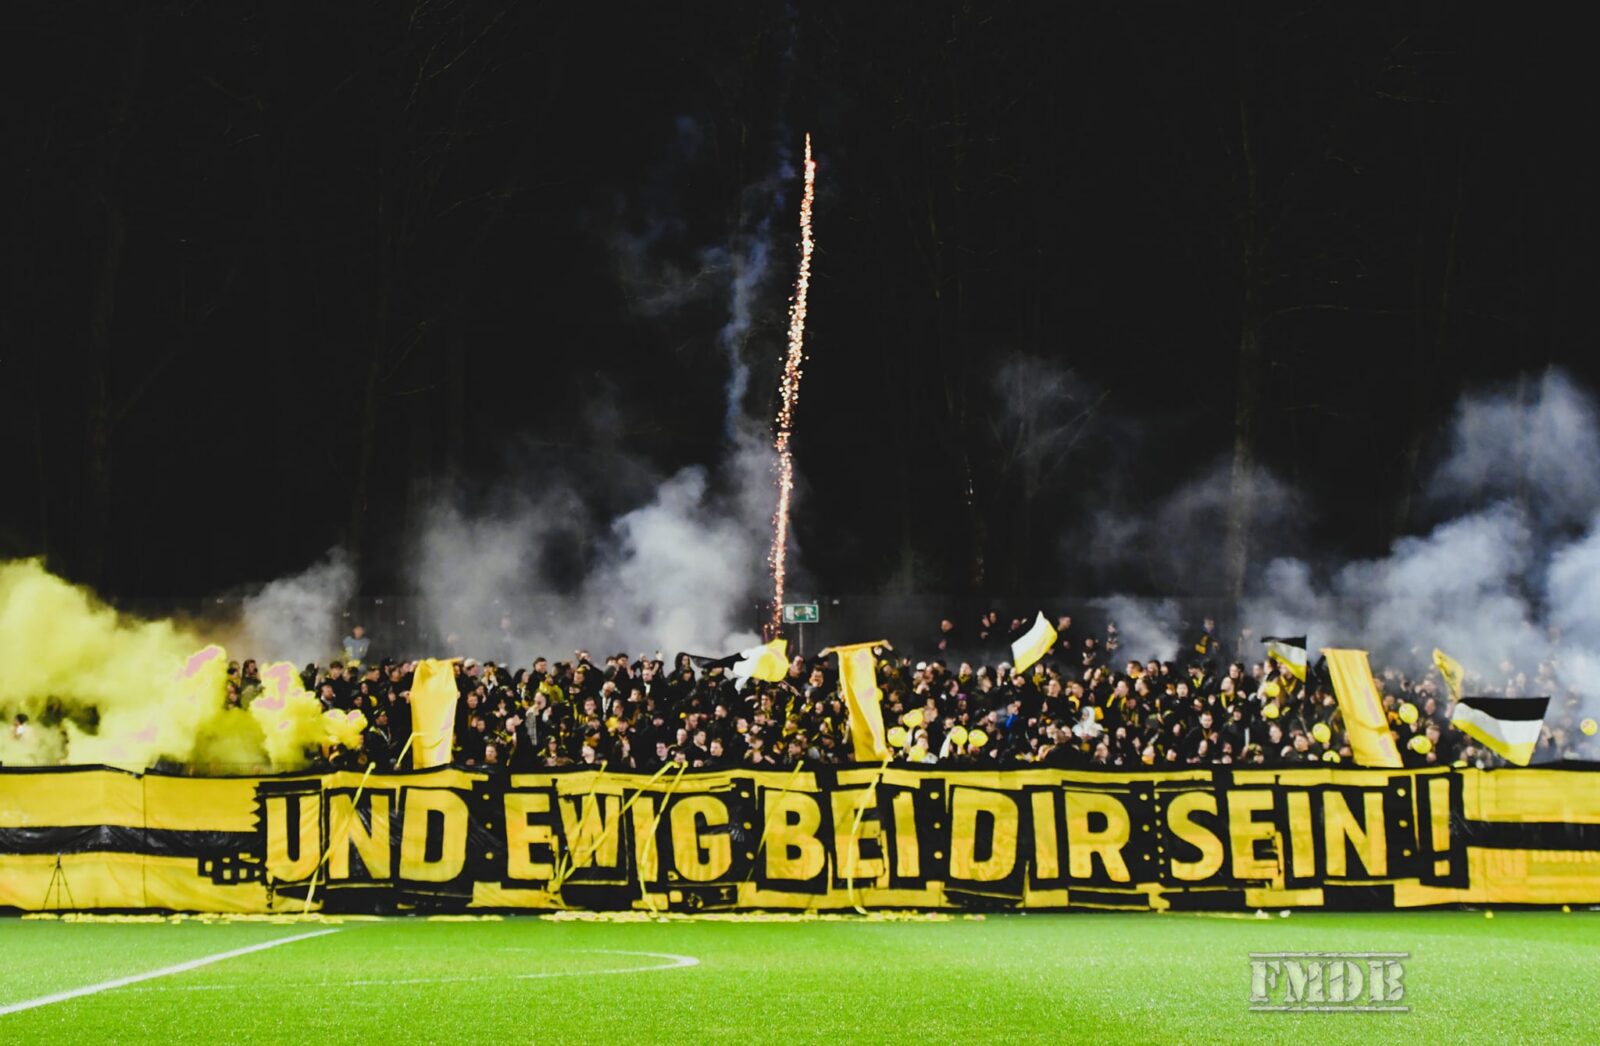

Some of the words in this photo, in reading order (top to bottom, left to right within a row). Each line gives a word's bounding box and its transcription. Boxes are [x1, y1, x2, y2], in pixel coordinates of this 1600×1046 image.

[264, 789, 469, 882] UND
[505, 794, 733, 882] EWIG
[765, 790, 920, 880] BEI
[949, 788, 1131, 882] DIR
